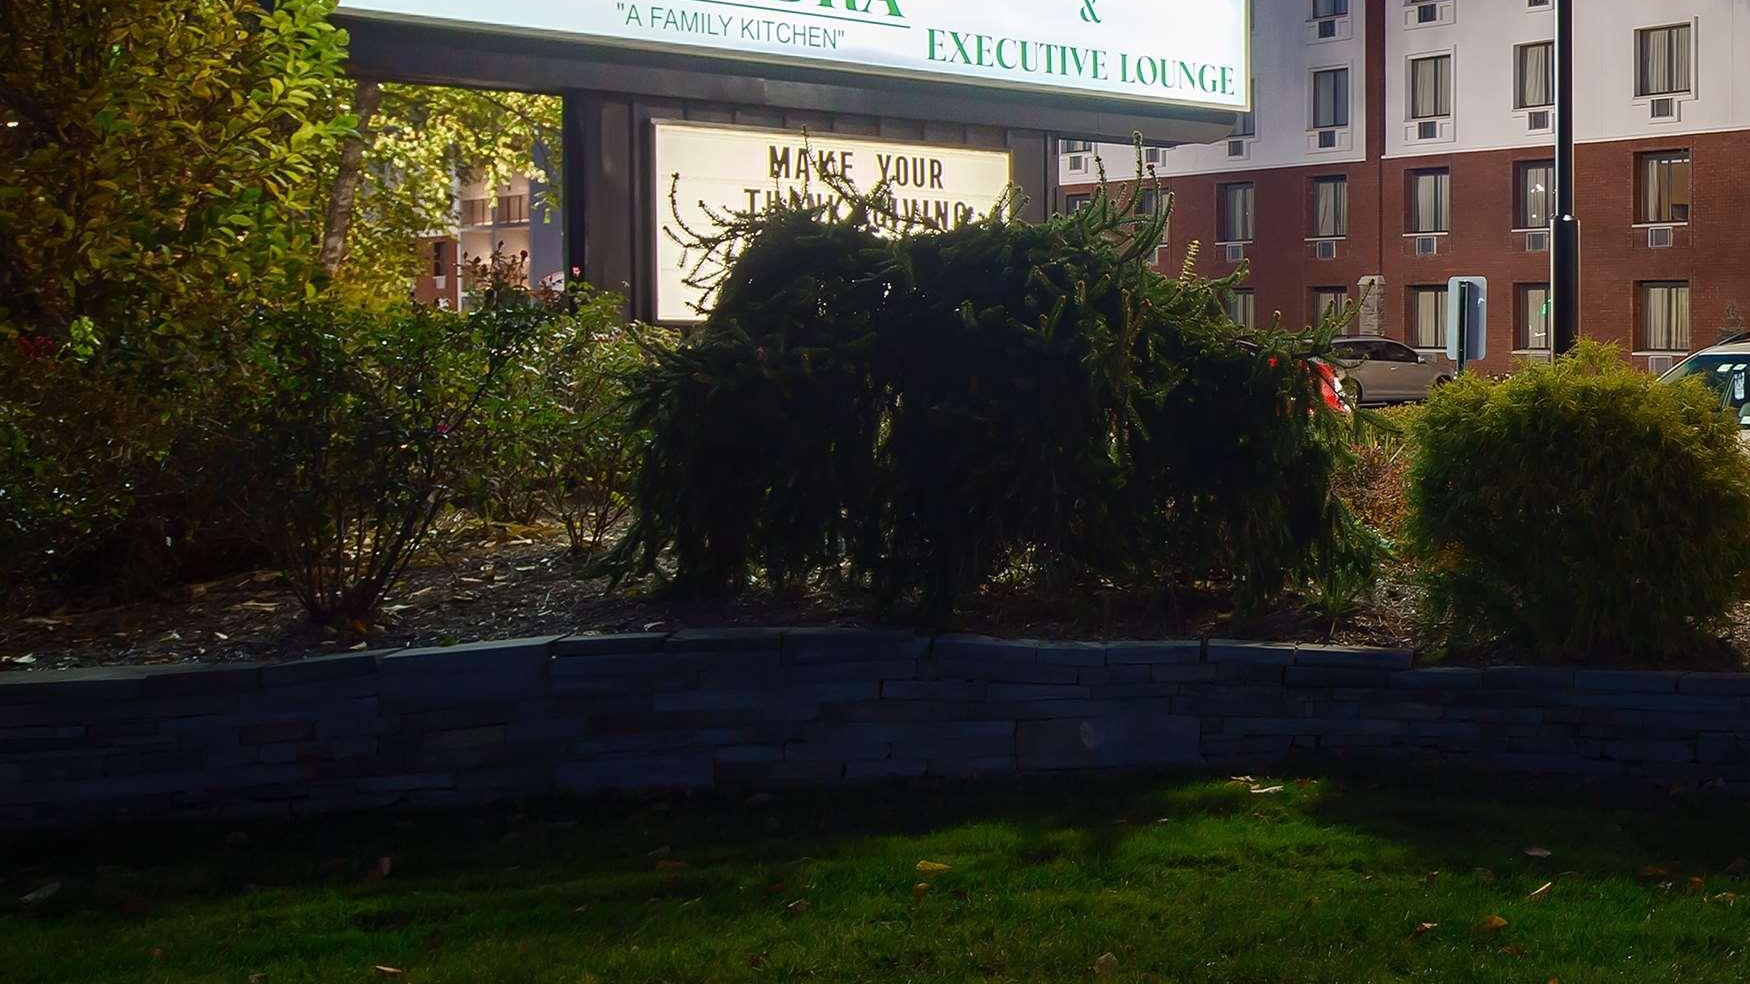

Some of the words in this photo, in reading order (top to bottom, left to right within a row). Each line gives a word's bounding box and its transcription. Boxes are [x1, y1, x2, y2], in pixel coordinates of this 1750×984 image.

[649, 6, 734, 39] FAMILY
[740, 17, 845, 51] KITCHEN"
[926, 27, 1109, 81] EXECUTIVE
[1119, 52, 1235, 96] LOUNGE
[768, 145, 854, 181] MAKE
[876, 153, 944, 190] YOUR
